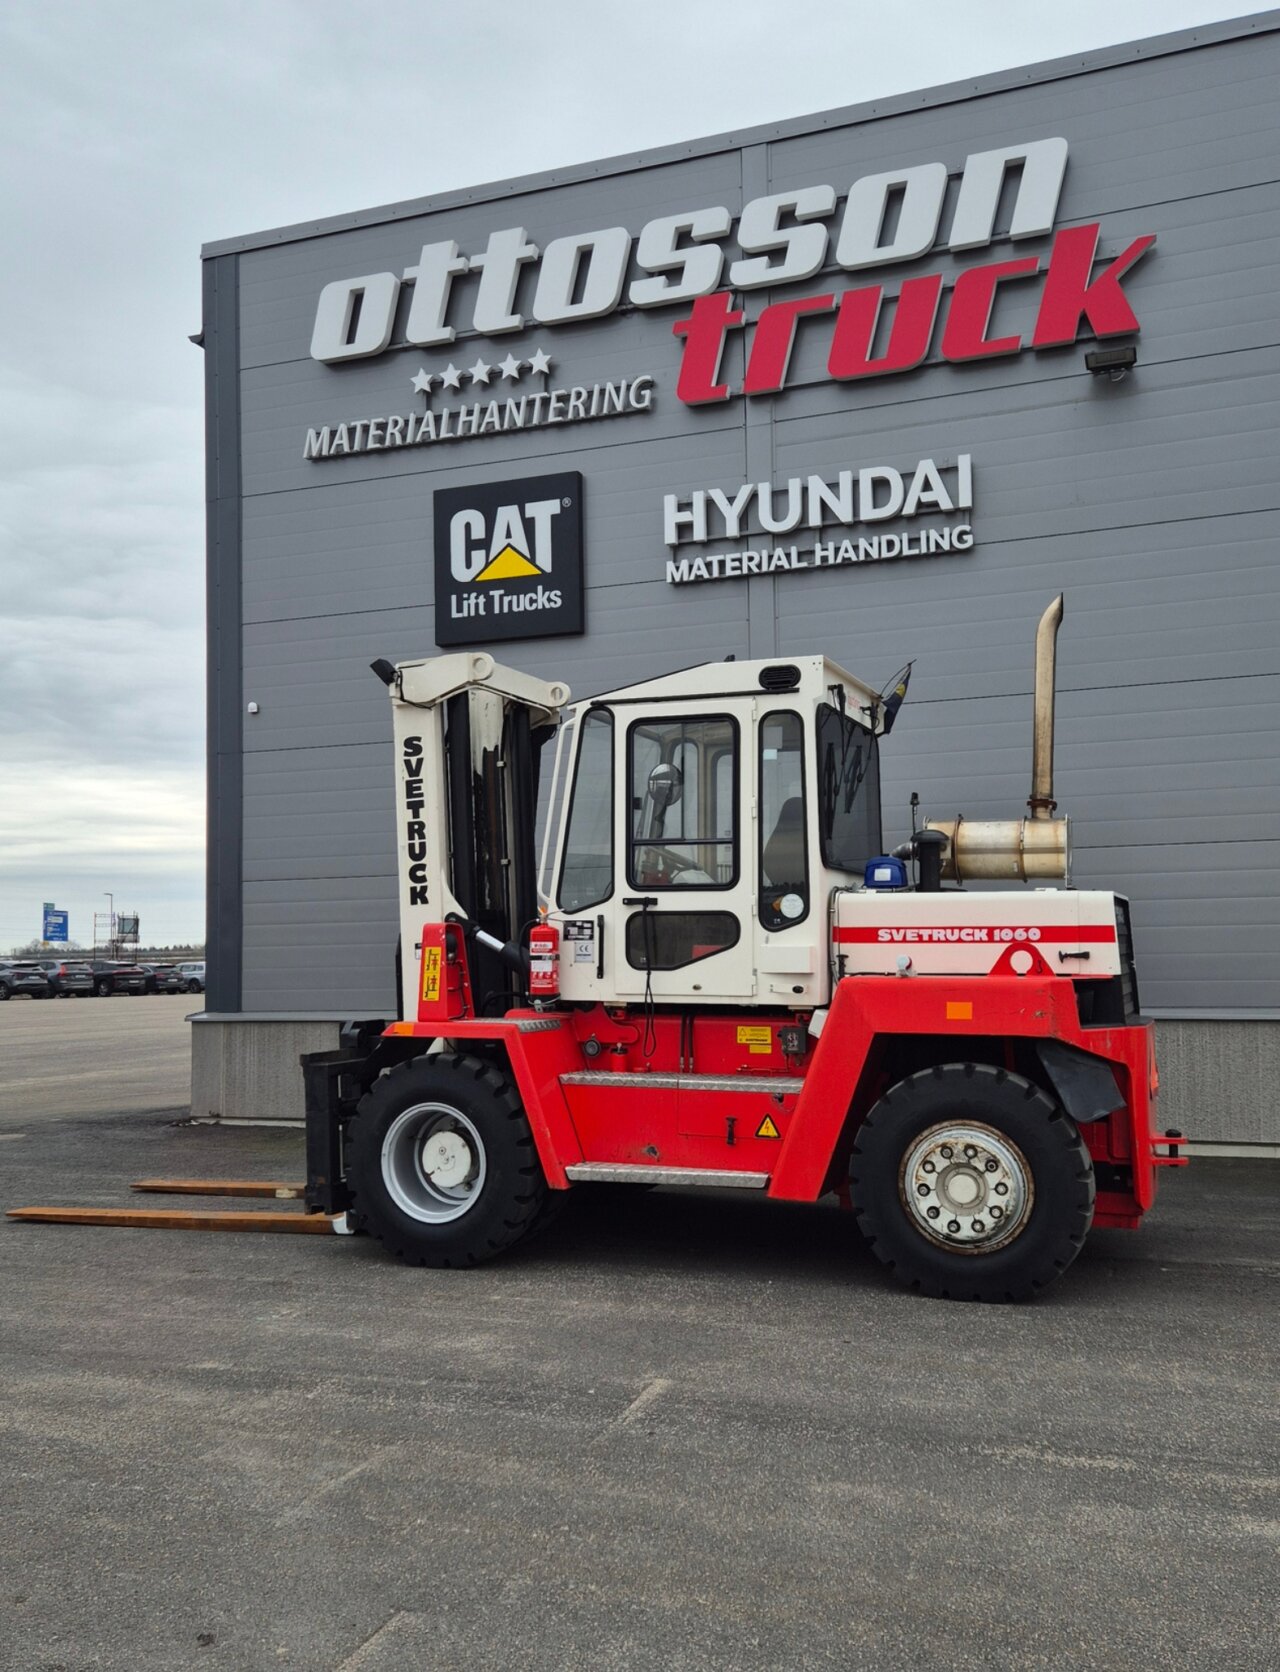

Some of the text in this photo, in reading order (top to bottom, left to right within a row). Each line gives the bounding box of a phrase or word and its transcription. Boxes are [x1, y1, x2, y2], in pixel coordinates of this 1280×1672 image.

[310, 137, 1068, 364] ottosson
[673, 222, 1157, 406] truck
[303, 375, 654, 460] MATERIALHANTERING
[450, 499, 561, 583] CAT
[664, 454, 973, 545] HYUNDAI
[666, 524, 974, 584] MATERIAL HANDLING
[451, 585, 563, 619] Lift Trucks
[403, 736, 429, 906] SVETRUCK
[877, 927, 1041, 942] SVETRUCK 1060
